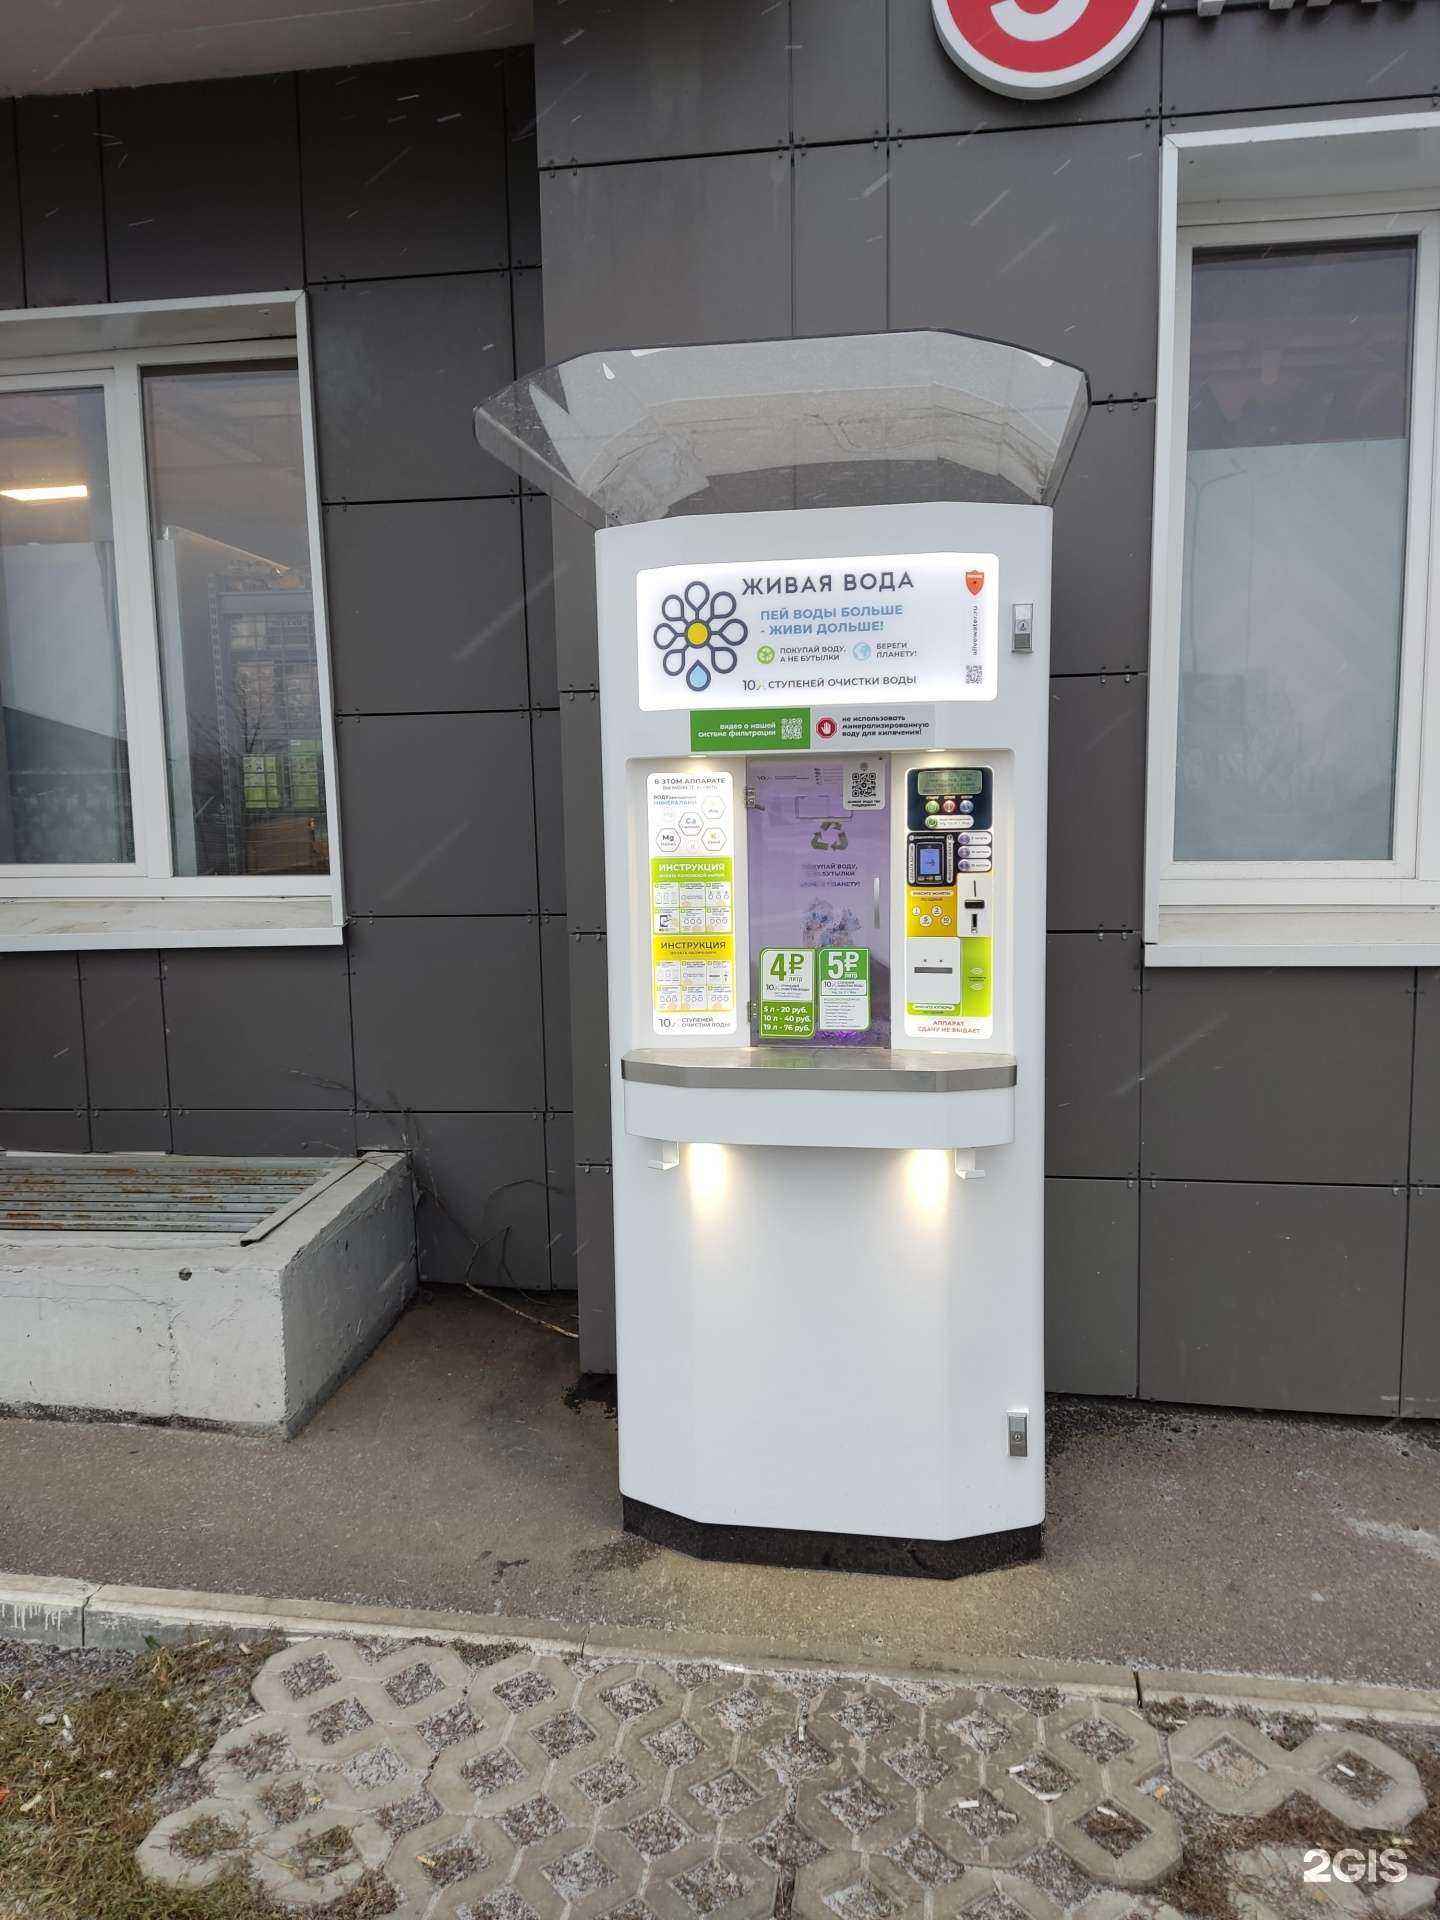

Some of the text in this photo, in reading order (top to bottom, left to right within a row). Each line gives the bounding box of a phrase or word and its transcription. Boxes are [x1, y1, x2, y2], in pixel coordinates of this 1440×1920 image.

[742, 571, 914, 596] ЖИВАЯ ВОДА
[760, 605, 903, 621] ПЕЙ ВОДЫ БОЛЬШЕ
[769, 624, 812, 636] ЖИВИ
[816, 621, 884, 635] ДОЛЬШЕ!
[779, 645, 820, 654] ПОКУПАЙ
[876, 642, 908, 650] БЕРЕГИ
[780, 655, 786, 663] А
[801, 654, 840, 662] БУТЫЛКИ
[876, 650, 917, 659] ПЛАНЕТУ!
[742, 675, 917, 691] 10 СТУПЕНЕЙ ОЧИСТКИ ВОДЫ
[728, 730, 776, 738] фильтрации
[862, 730, 876, 738] для
[659, 863, 726, 872] ИНСТРУКЦИЯ
[661, 942, 726, 950] ИНСТРУКЦИЯ
